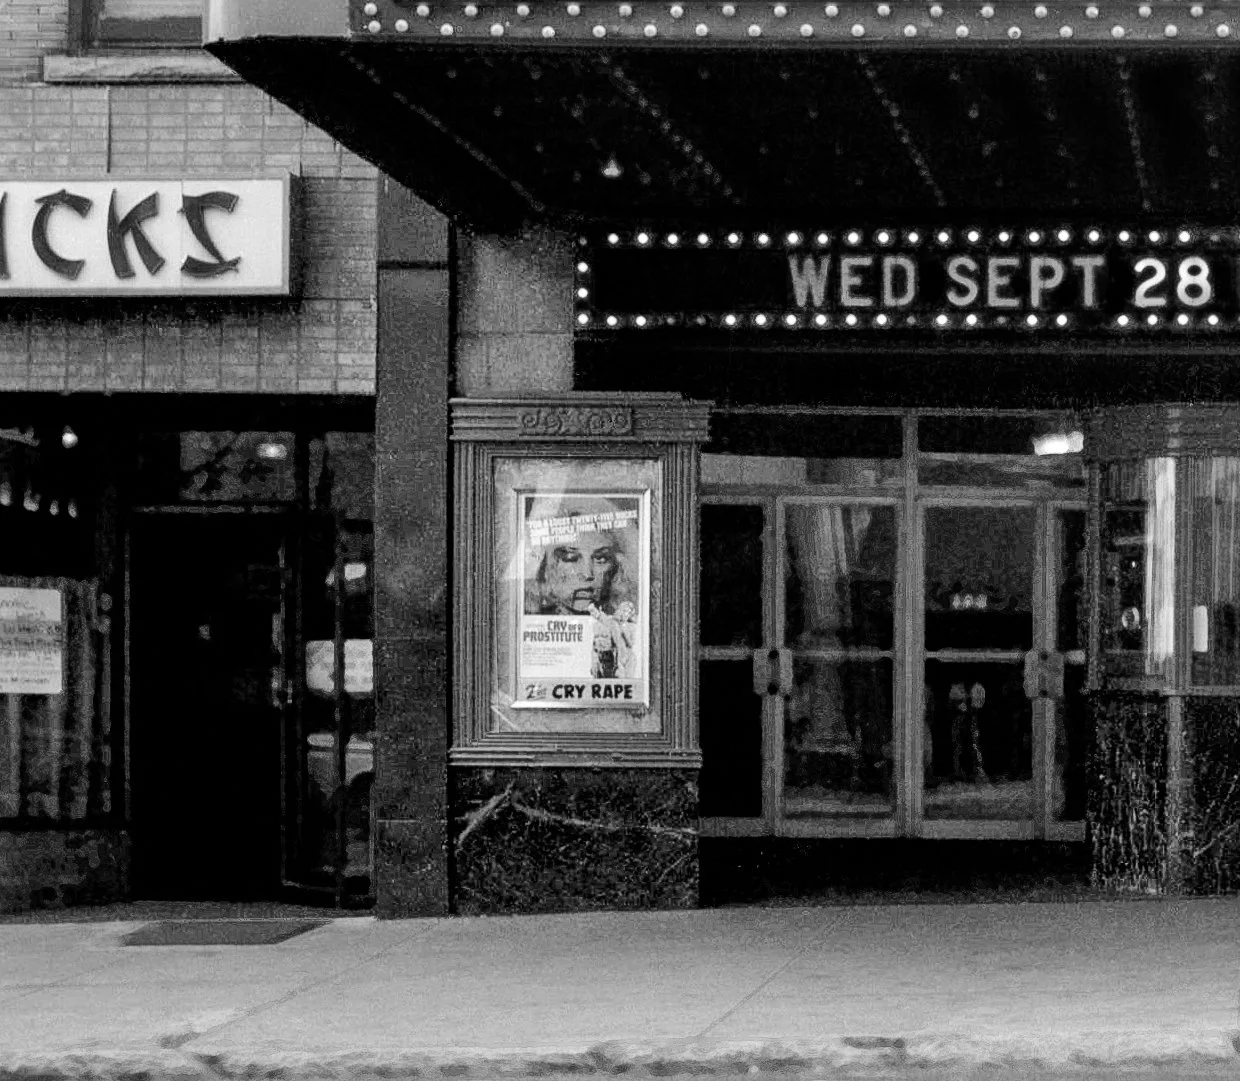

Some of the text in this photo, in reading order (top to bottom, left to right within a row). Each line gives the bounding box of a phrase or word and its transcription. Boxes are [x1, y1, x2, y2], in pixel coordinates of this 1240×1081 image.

[788, 255, 918, 307] WED
[946, 256, 1105, 308] SEPT
[1133, 256, 1212, 308] 28
[547, 620, 567, 631] CRY
[523, 631, 583, 642] PROSTITUTE
[552, 684, 585, 699] CRY
[592, 684, 633, 699] RAPE
